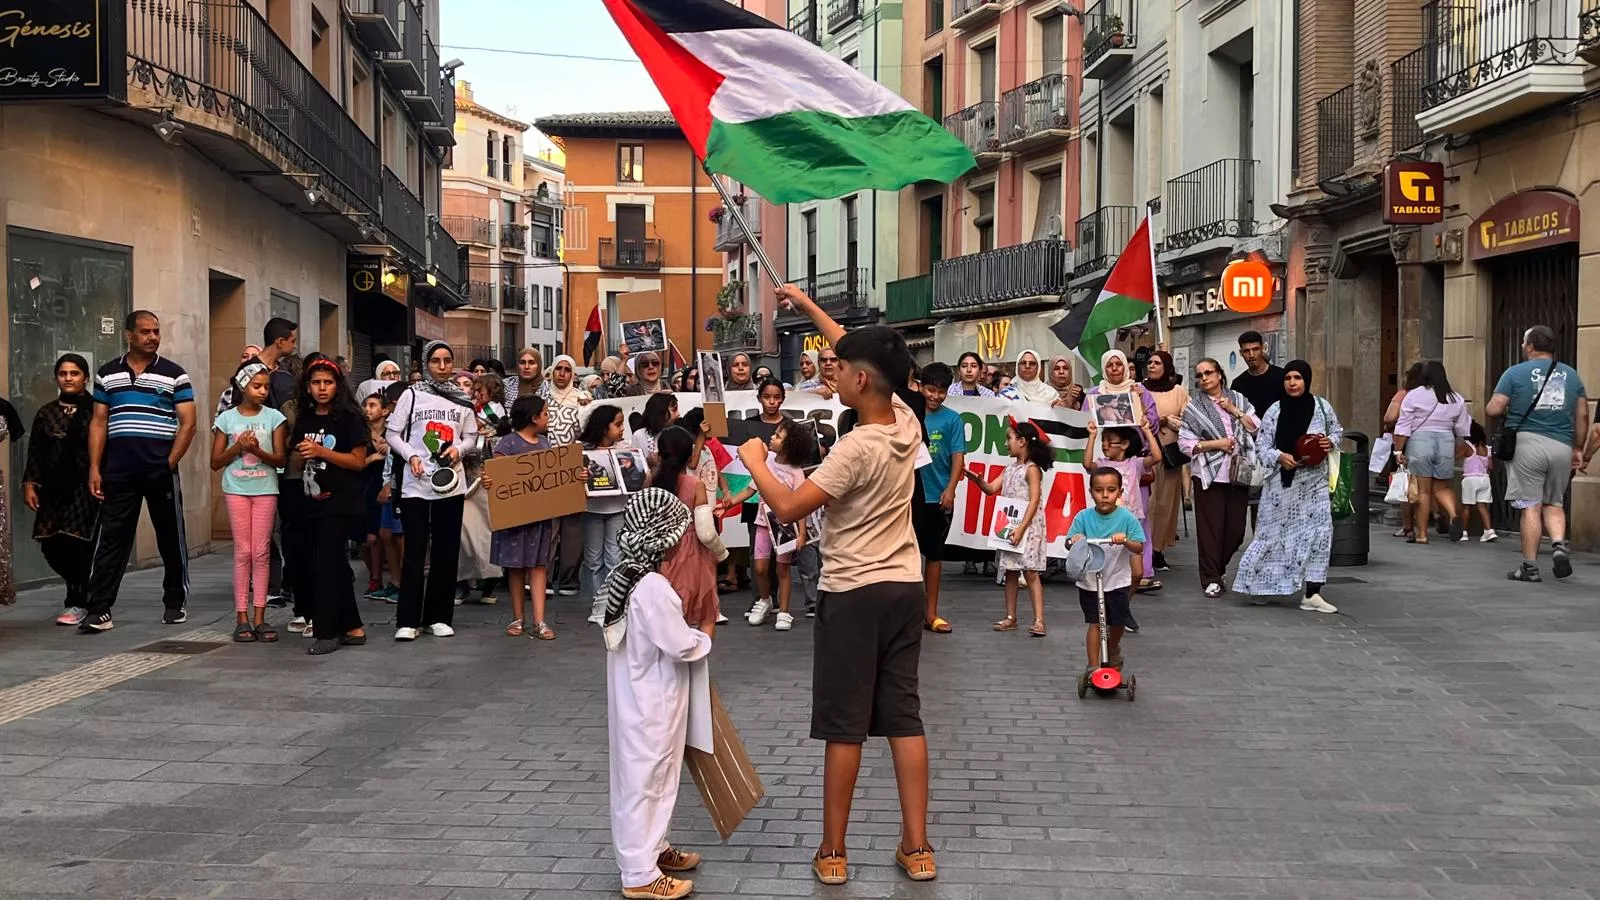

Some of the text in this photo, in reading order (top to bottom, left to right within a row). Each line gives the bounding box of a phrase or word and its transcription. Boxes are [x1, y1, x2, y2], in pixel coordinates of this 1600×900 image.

[0, 10, 91, 48] Génesis
[1392, 206, 1441, 214] TABACOS
[1504, 211, 1559, 237] TABACOS
[1167, 291, 1204, 318] HOME
[516, 446, 569, 475] STOP
